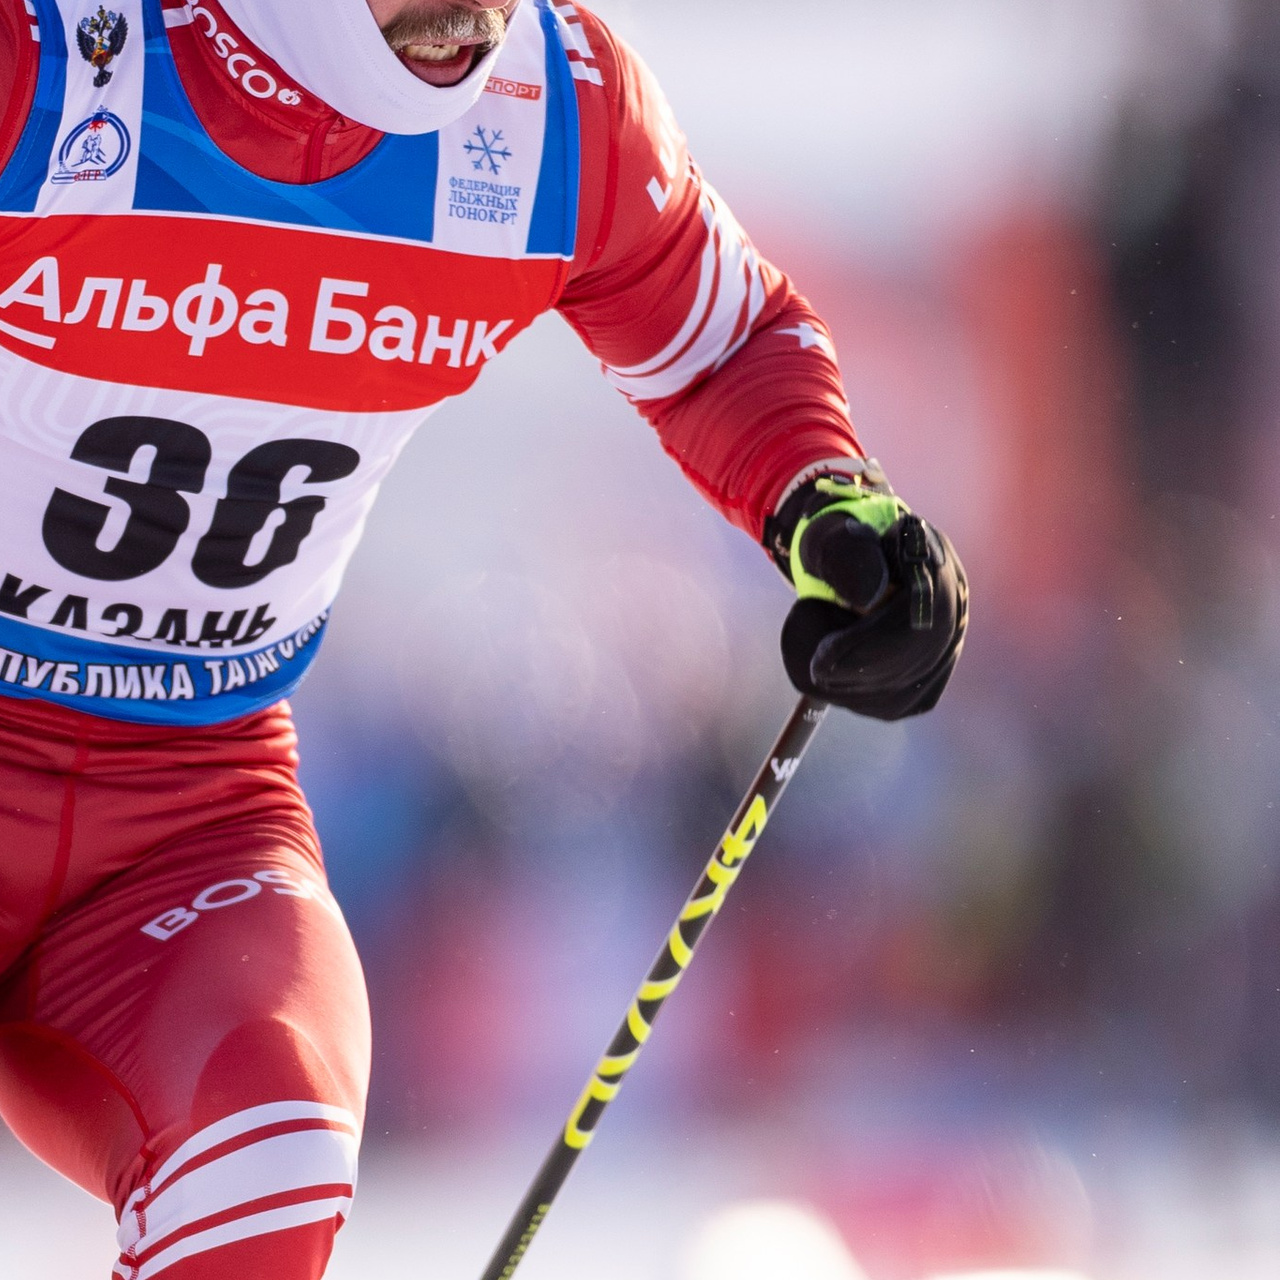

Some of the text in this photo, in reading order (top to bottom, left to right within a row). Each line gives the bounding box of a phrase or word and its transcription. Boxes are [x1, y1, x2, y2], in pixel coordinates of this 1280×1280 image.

[449, 176, 521, 197] ФЕДЕРАЦИЯ
[449, 190, 518, 210] ЛЫЖНЫХ
[449, 204, 518, 225] ГОНОК РТ
[309, 277, 513, 368] Банк
[41, 415, 360, 588] 36
